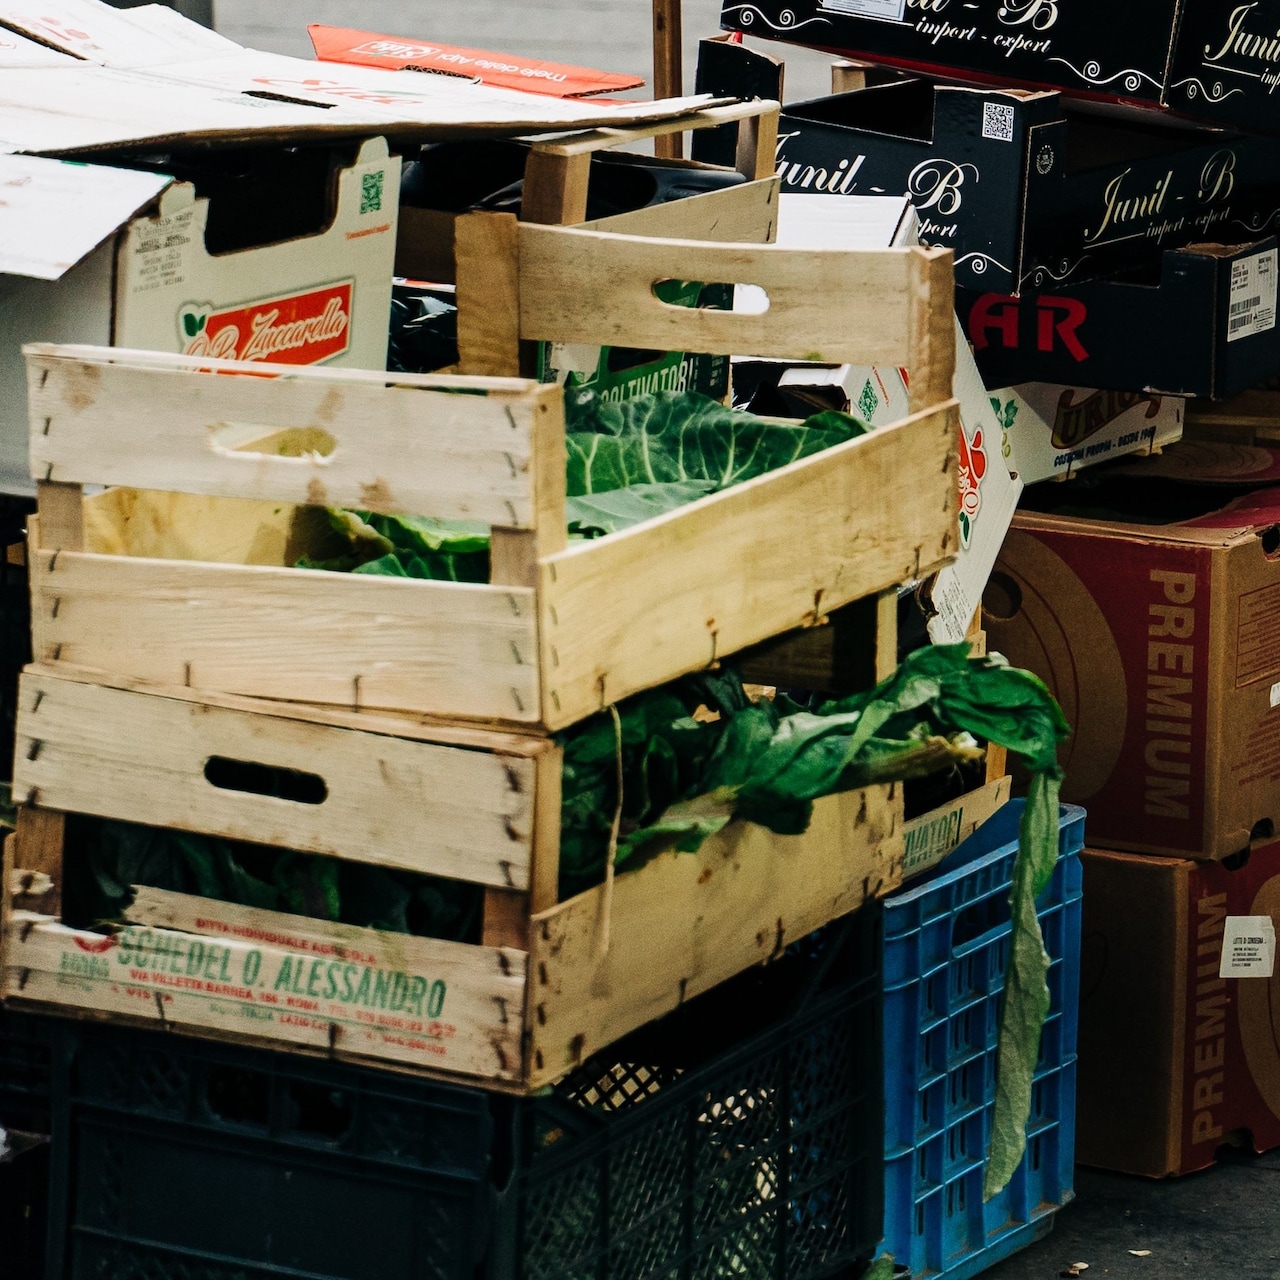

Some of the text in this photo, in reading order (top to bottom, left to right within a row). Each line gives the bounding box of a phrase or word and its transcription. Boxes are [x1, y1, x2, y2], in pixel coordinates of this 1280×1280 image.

[916, 17, 976, 44] import
[994, 33, 1052, 57] export
[435, 52, 567, 83] mele delle Alpi
[904, 158, 980, 215] B
[1084, 167, 1173, 242] Junil
[1198, 148, 1236, 203] B
[919, 218, 958, 238] port
[1146, 217, 1184, 245] import
[1195, 207, 1231, 234] export
[1144, 569, 1197, 820] PREMIUM
[117, 927, 233, 983] SCHEDEL
[242, 950, 266, 988] O.
[274, 954, 448, 1018] ALESSANDRO
[130, 969, 149, 981] VIA
[1192, 892, 1227, 1144] PREMIUM
